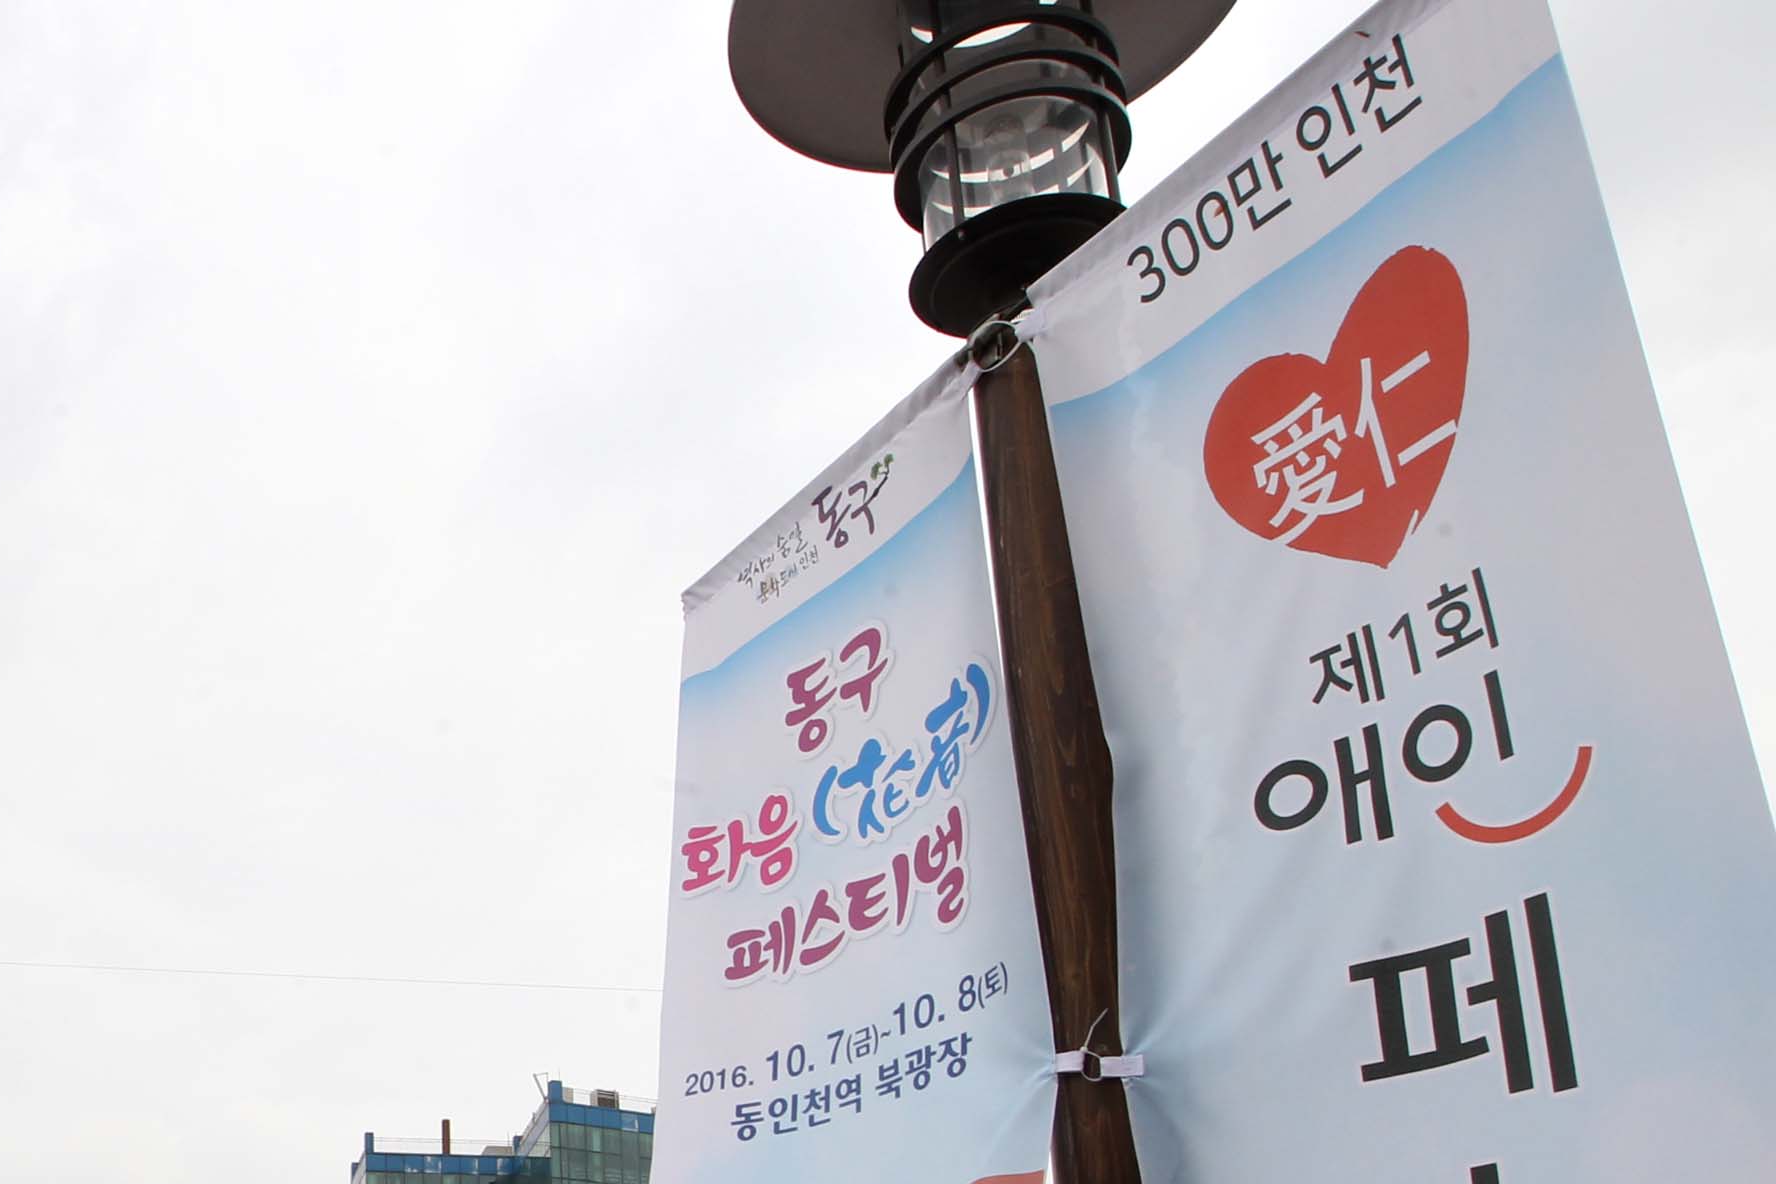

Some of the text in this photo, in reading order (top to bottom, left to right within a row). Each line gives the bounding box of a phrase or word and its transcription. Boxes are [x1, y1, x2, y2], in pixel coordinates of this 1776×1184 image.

[1125, 32, 1423, 304] 300만 인천
[810, 479, 889, 549] 동구
[1252, 350, 1458, 545] 愛仁
[785, 627, 890, 753] 동구
[1309, 566, 1500, 705] 제1회
[680, 794, 799, 892] 화음
[724, 804, 967, 981] 페스티벌
[683, 1065, 756, 1098] 2016.
[765, 1043, 816, 1084] 10.
[957, 960, 1010, 1013] 8(토)
[730, 1030, 974, 1142] 동인천역 북광장
